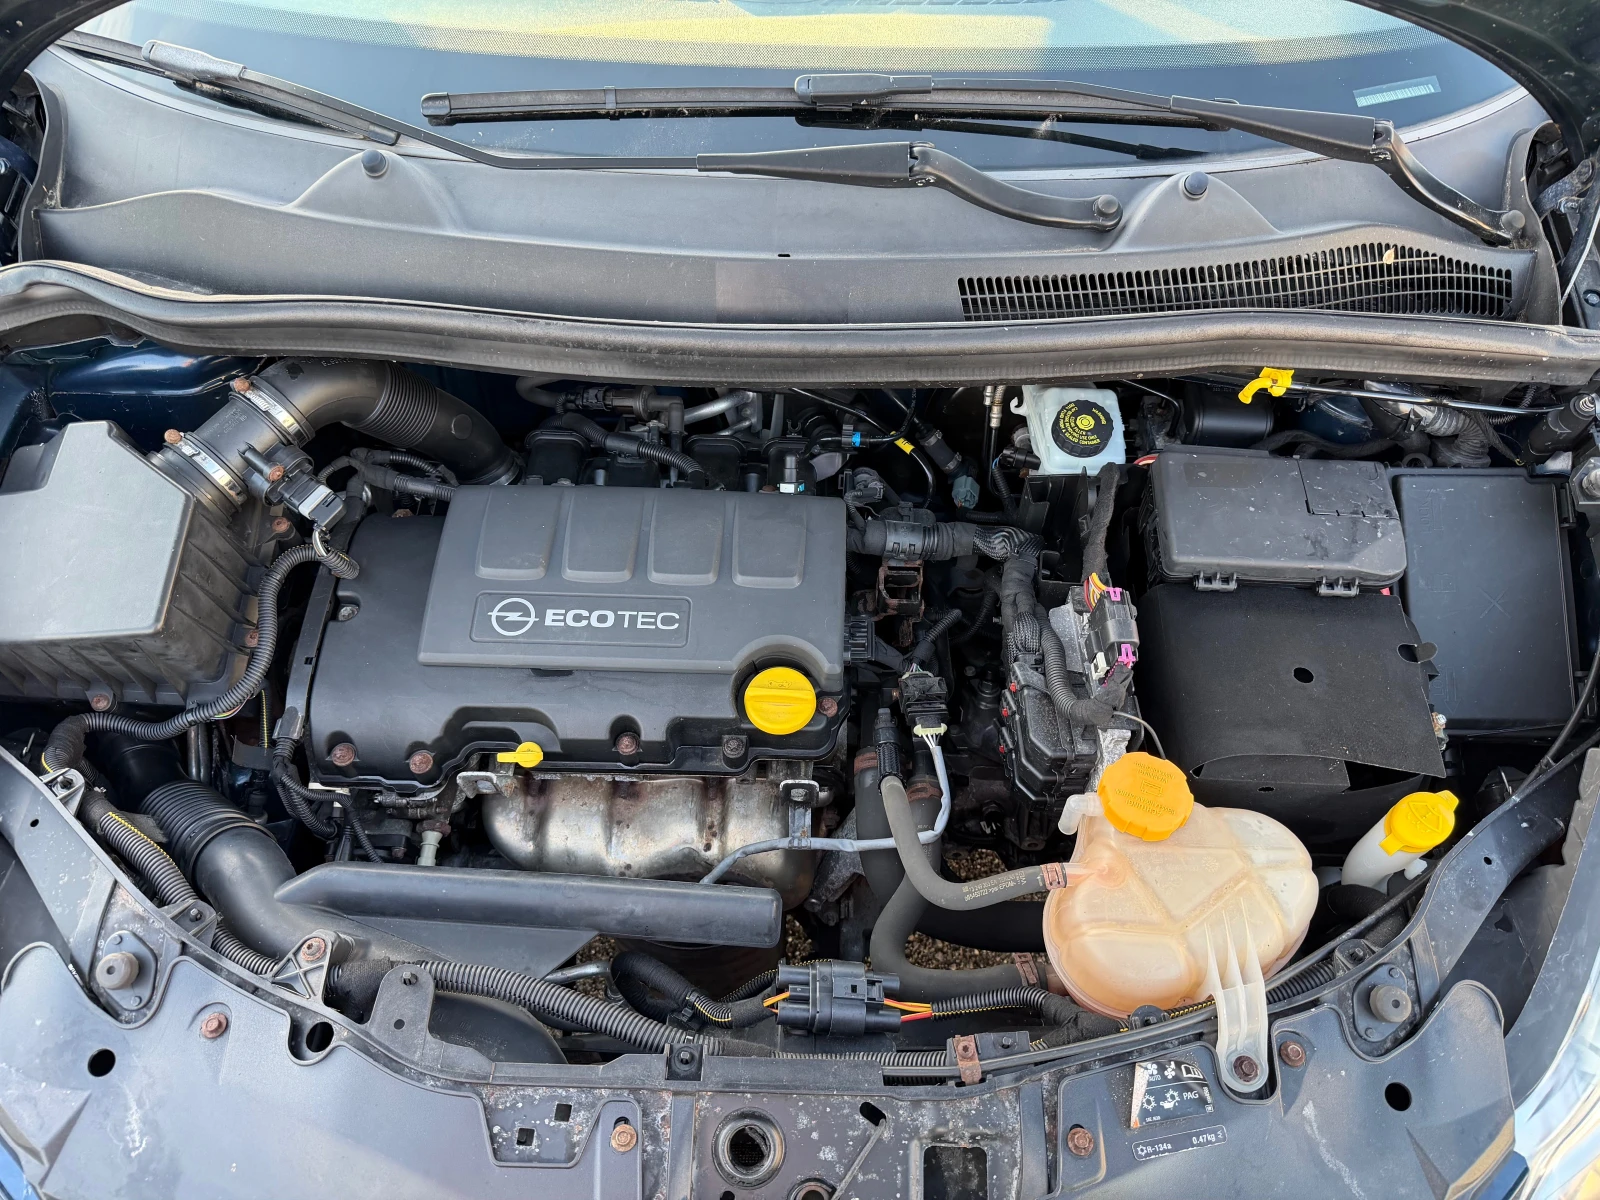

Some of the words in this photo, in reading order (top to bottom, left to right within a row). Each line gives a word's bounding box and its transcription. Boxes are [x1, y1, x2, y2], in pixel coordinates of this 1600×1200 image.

[544, 608, 680, 630] ECOTEC
[1183, 1090, 1199, 1100] PAG
[1146, 1142, 1172, 1153] R-134a
